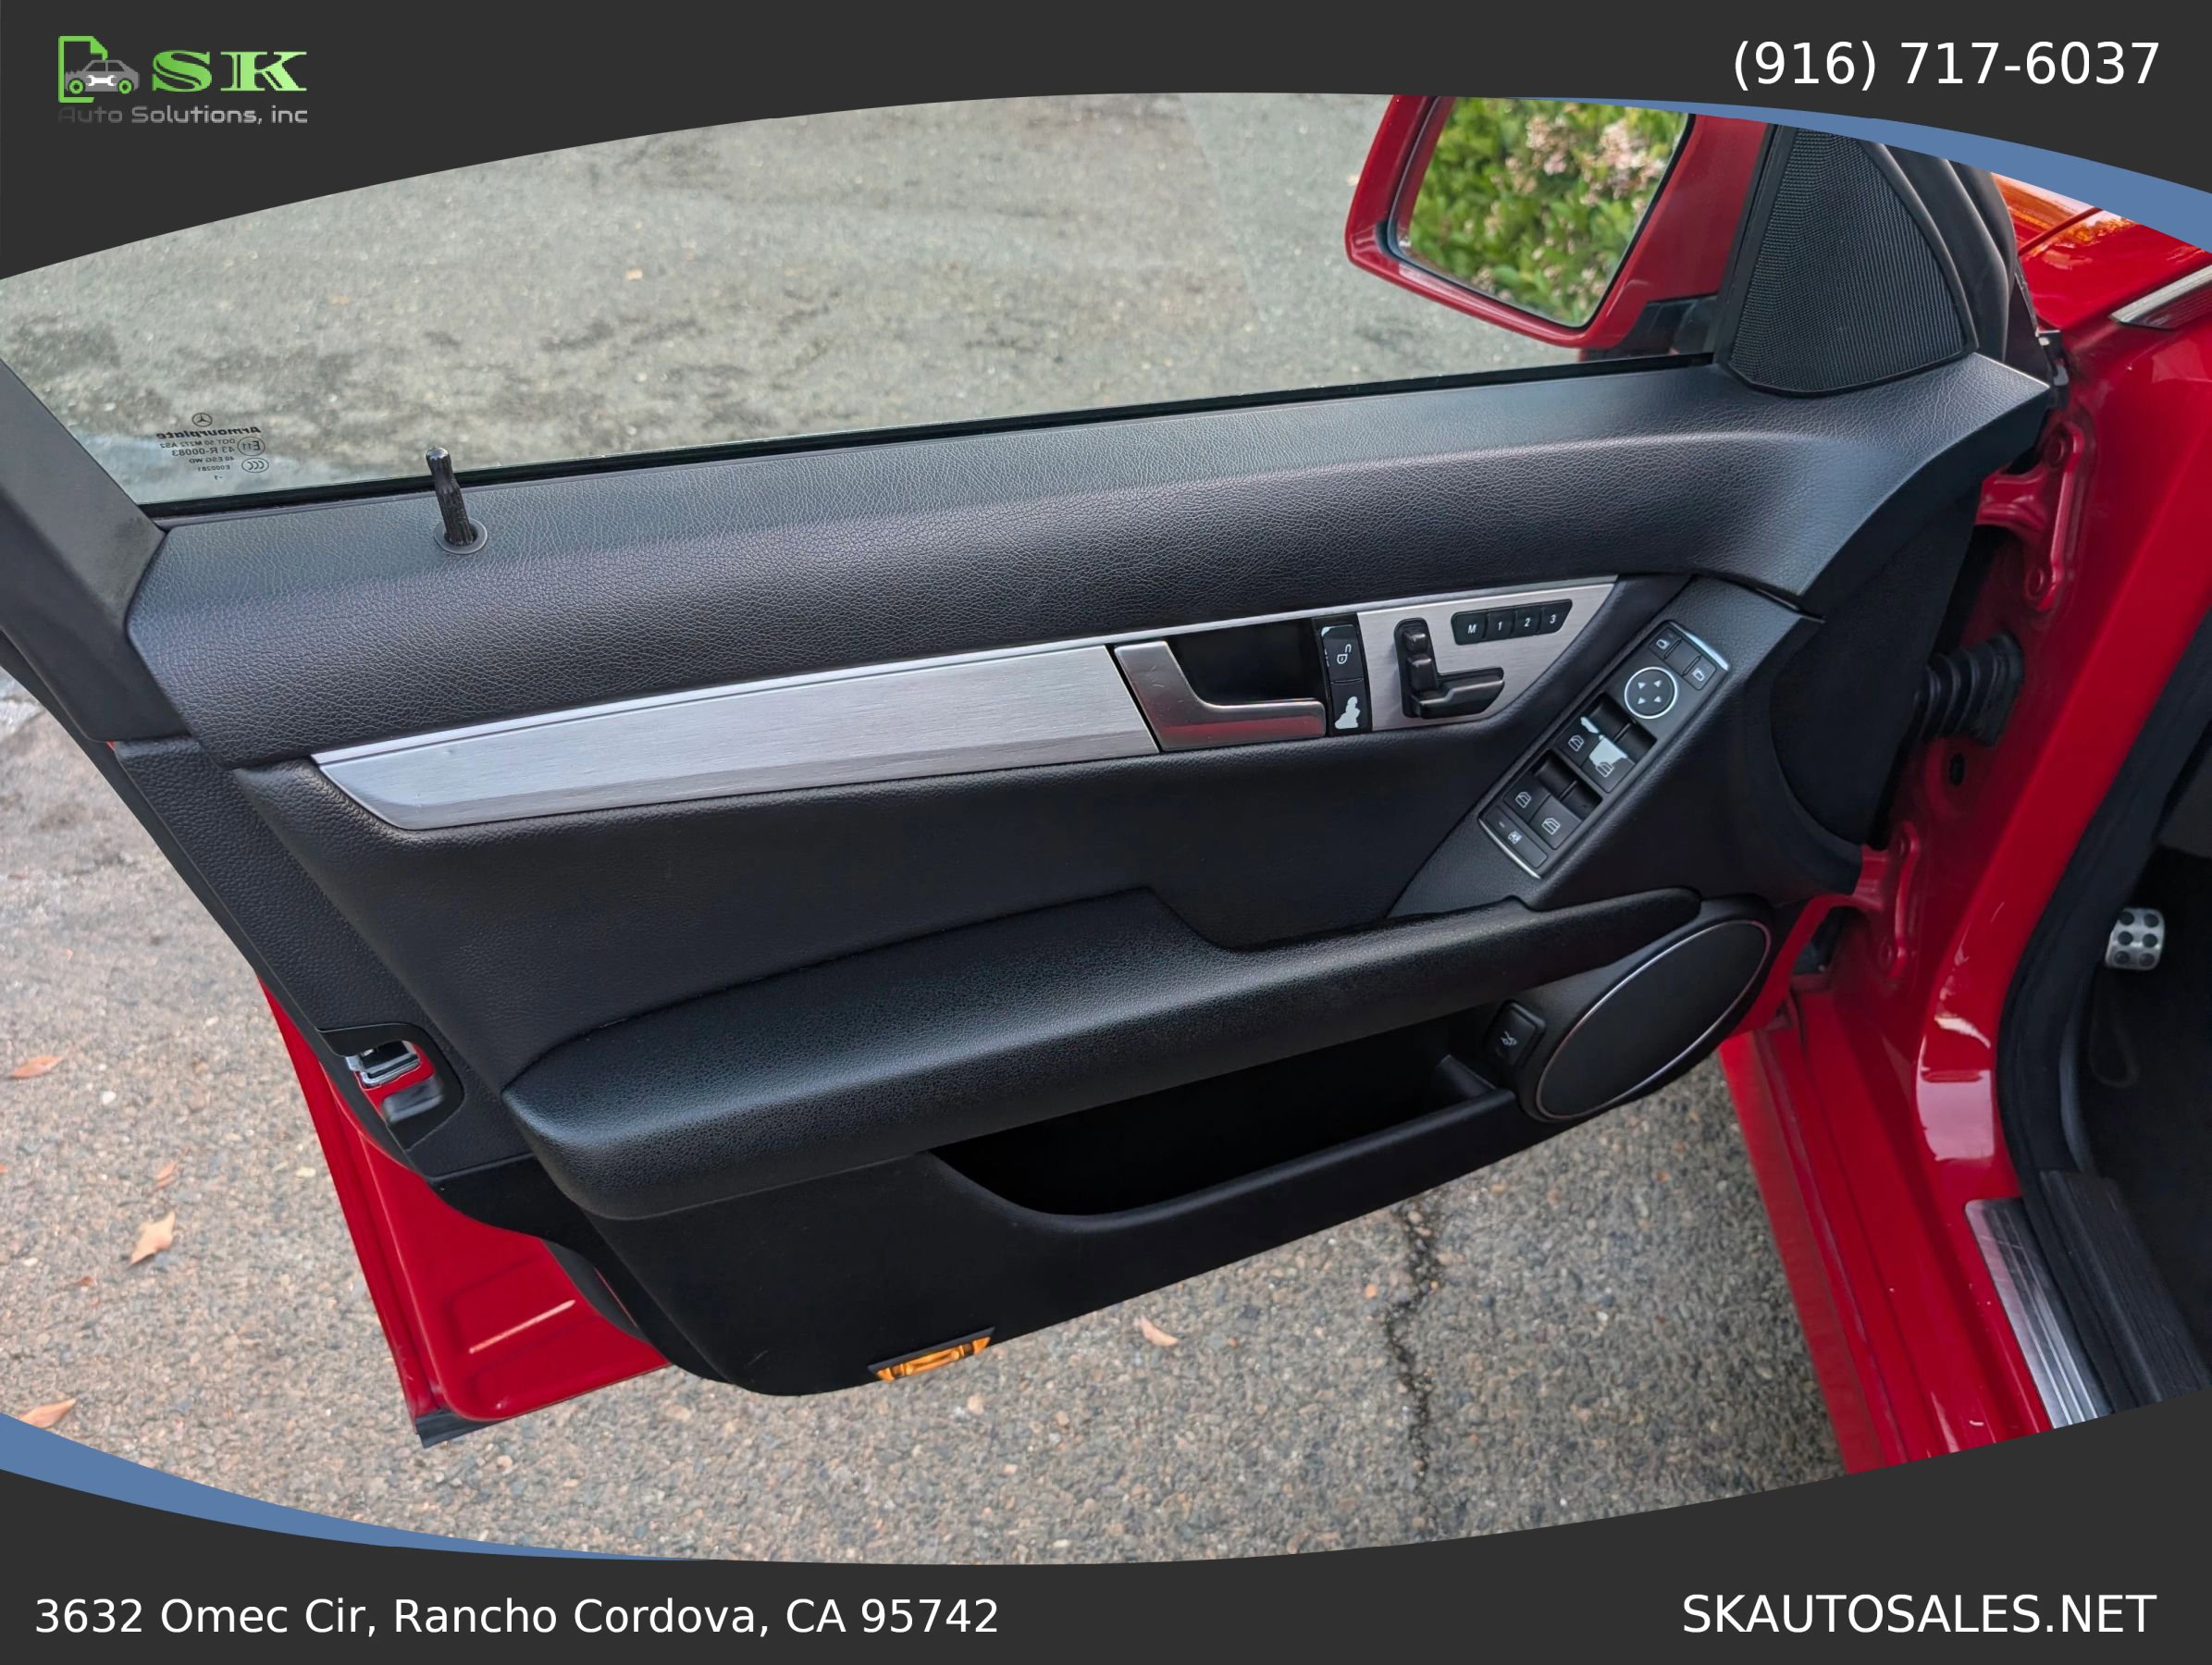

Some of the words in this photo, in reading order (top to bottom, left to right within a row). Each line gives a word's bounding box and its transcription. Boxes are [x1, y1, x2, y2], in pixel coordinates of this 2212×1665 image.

[1467, 623, 1477, 635] M
[1498, 622, 1502, 631] 1
[1524, 618, 1531, 627] 2
[1549, 614, 1557, 624] 3
